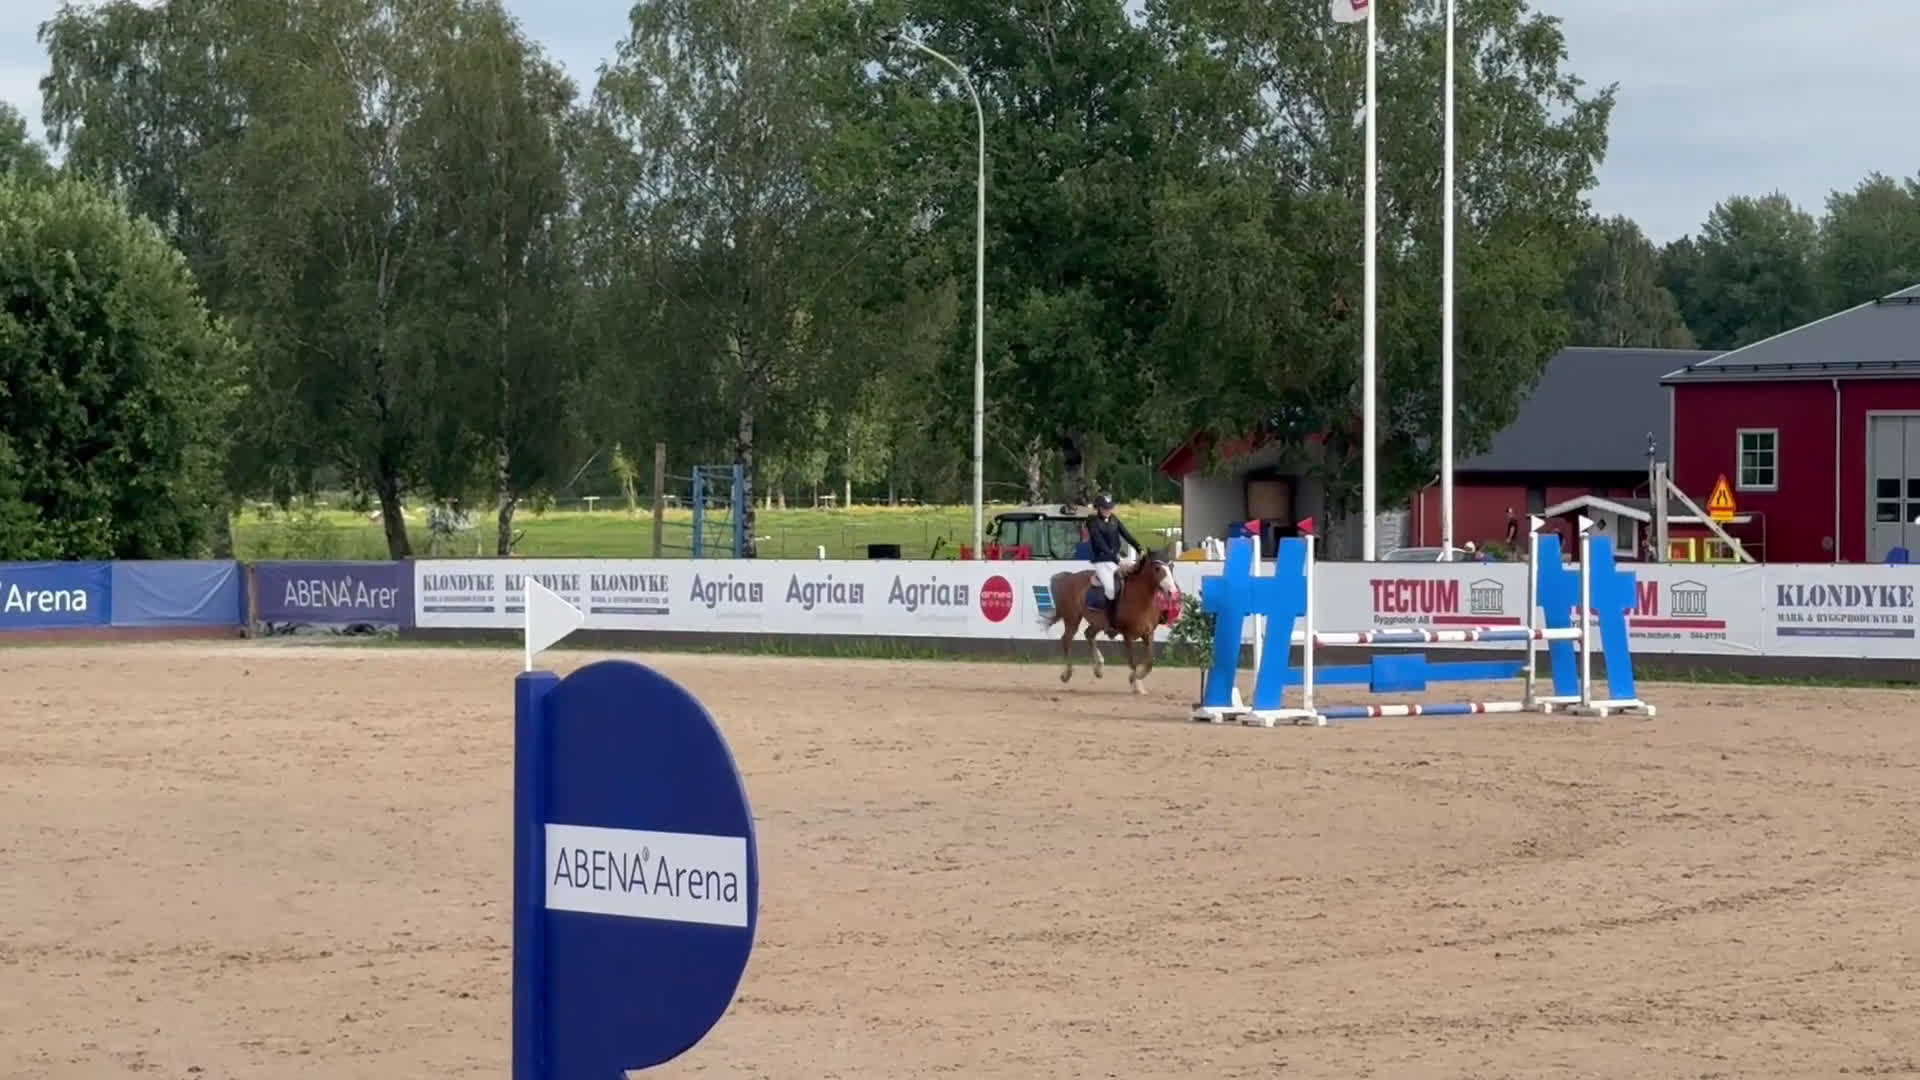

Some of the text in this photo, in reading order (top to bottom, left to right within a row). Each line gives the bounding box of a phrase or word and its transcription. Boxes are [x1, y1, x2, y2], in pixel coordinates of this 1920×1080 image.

[4, 583, 87, 613] Arena
[423, 574, 495, 591] KLONDYKE
[591, 574, 669, 592] KLONDYKE
[689, 573, 747, 609] Agria
[785, 573, 847, 611] Agria
[888, 575, 951, 612] Agria
[1370, 579, 1459, 613] TECTUM
[1777, 584, 1914, 607] KLONDYKE
[1778, 613, 1804, 622] MARK
[653, 856, 738, 902] Arena
